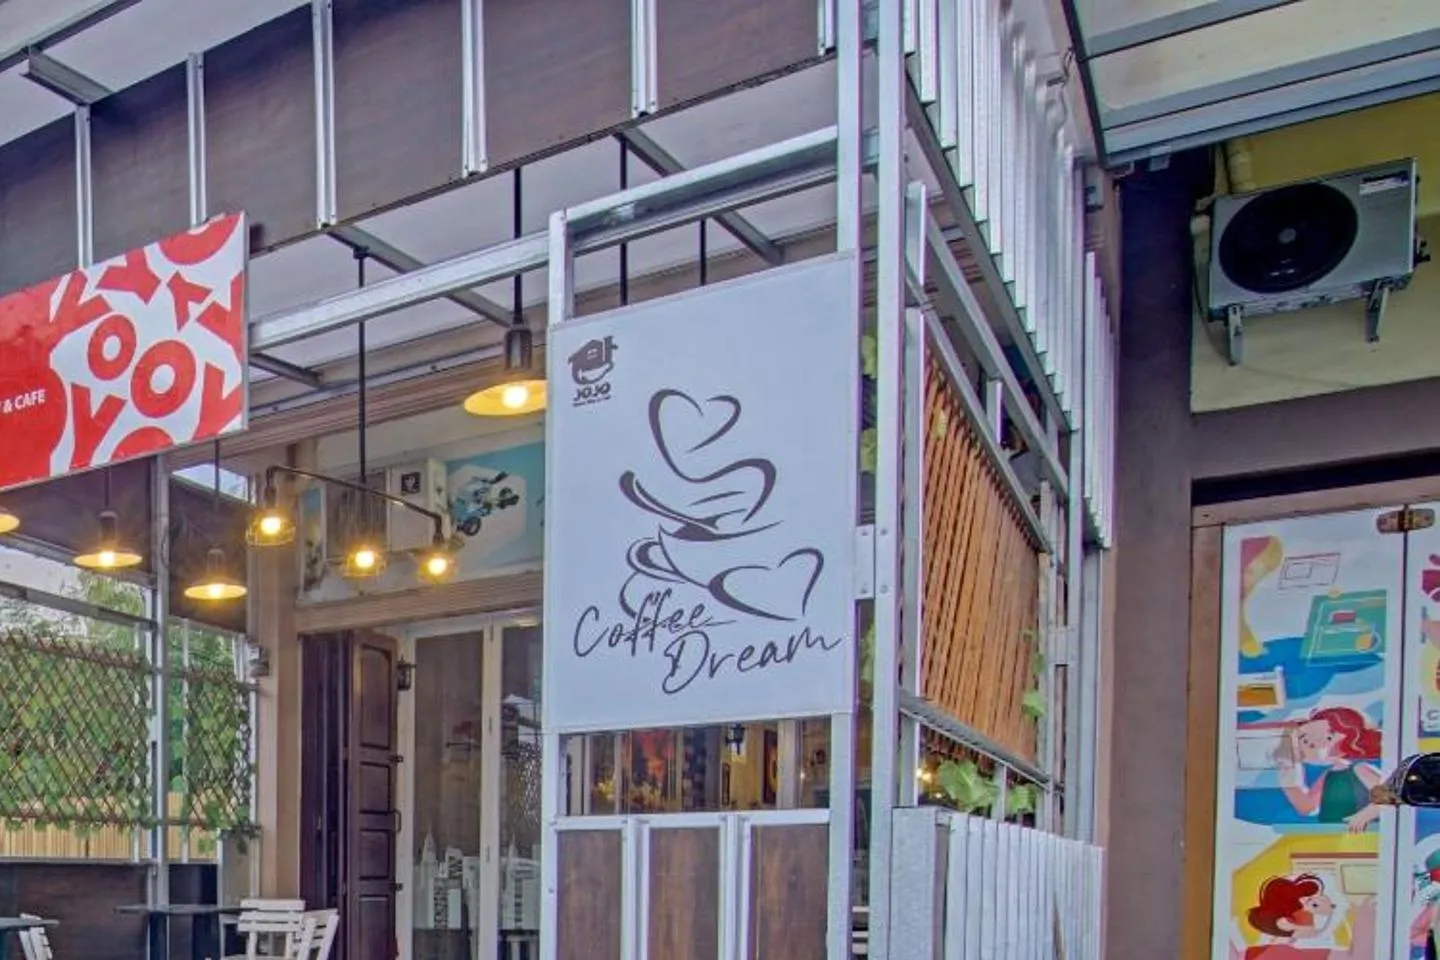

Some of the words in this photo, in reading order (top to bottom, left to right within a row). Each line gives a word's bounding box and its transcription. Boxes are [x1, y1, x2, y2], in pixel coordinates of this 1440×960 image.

[3, 399, 13, 414] &
[15, 389, 47, 410] CAFE
[573, 382, 612, 401] JOJO
[574, 588, 737, 658] Coffee
[662, 626, 842, 694] Dream
